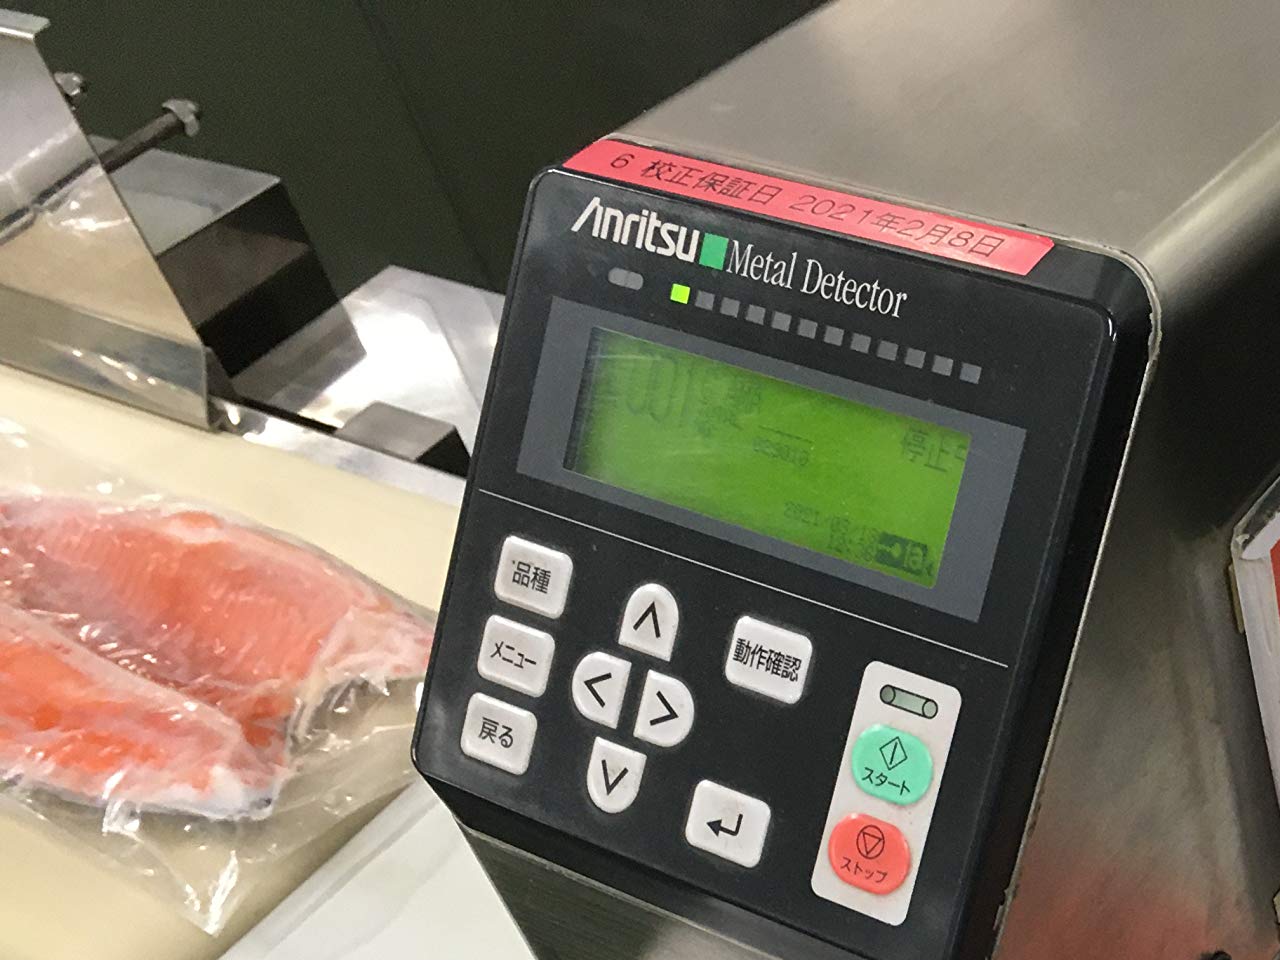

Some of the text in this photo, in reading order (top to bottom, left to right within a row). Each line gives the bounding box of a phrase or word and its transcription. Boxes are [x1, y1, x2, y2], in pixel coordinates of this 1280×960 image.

[610, 152, 1005, 259] 6 校正保証日 2021年2月8日
[571, 197, 908, 319] Anritsu Metal Detector
[512, 561, 551, 595] 品種
[490, 640, 537, 670] メニュー
[733, 637, 803, 684] 動作確認
[478, 716, 515, 750] 戻る
[861, 766, 911, 797] スタート
[840, 856, 889, 884] ストップ
